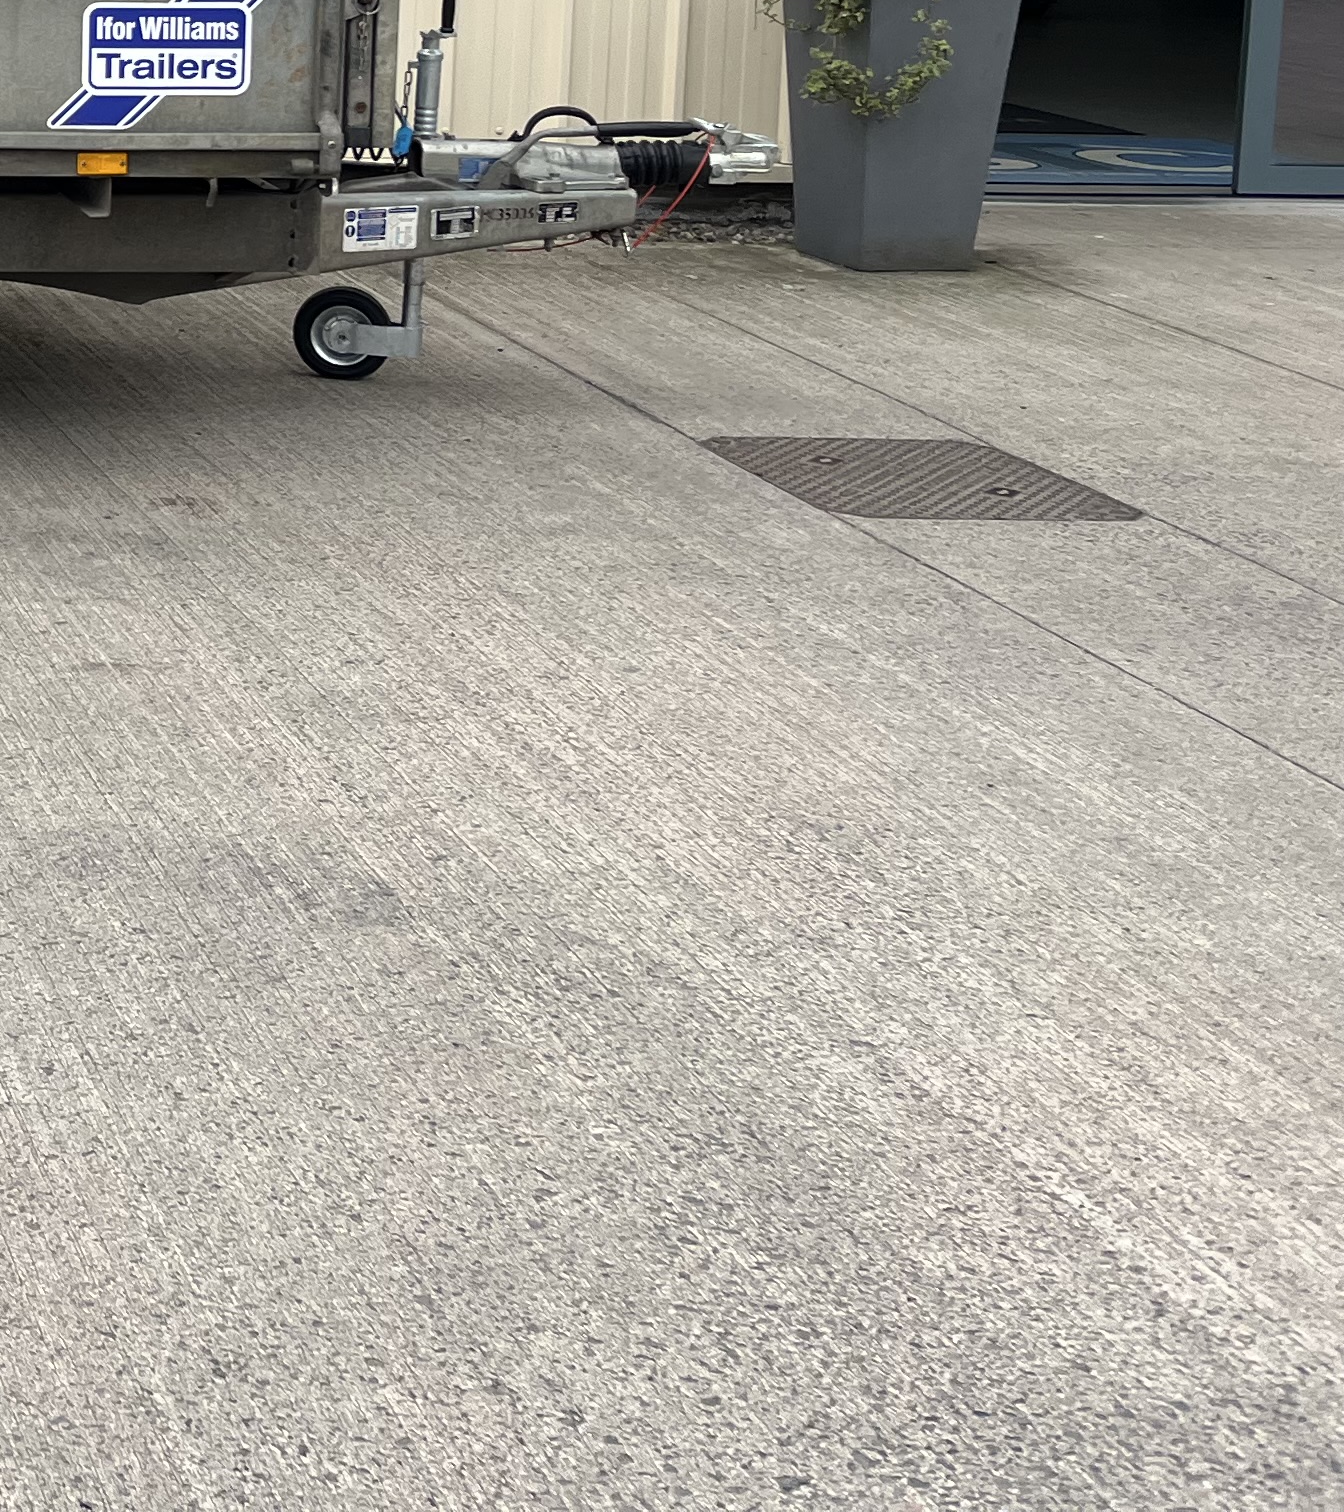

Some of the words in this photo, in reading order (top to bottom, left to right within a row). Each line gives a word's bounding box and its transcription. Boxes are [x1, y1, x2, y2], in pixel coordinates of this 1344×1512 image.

[97, 16, 135, 40] Ifor
[139, 17, 239, 40] Williams
[96, 53, 238, 80] Trailers
